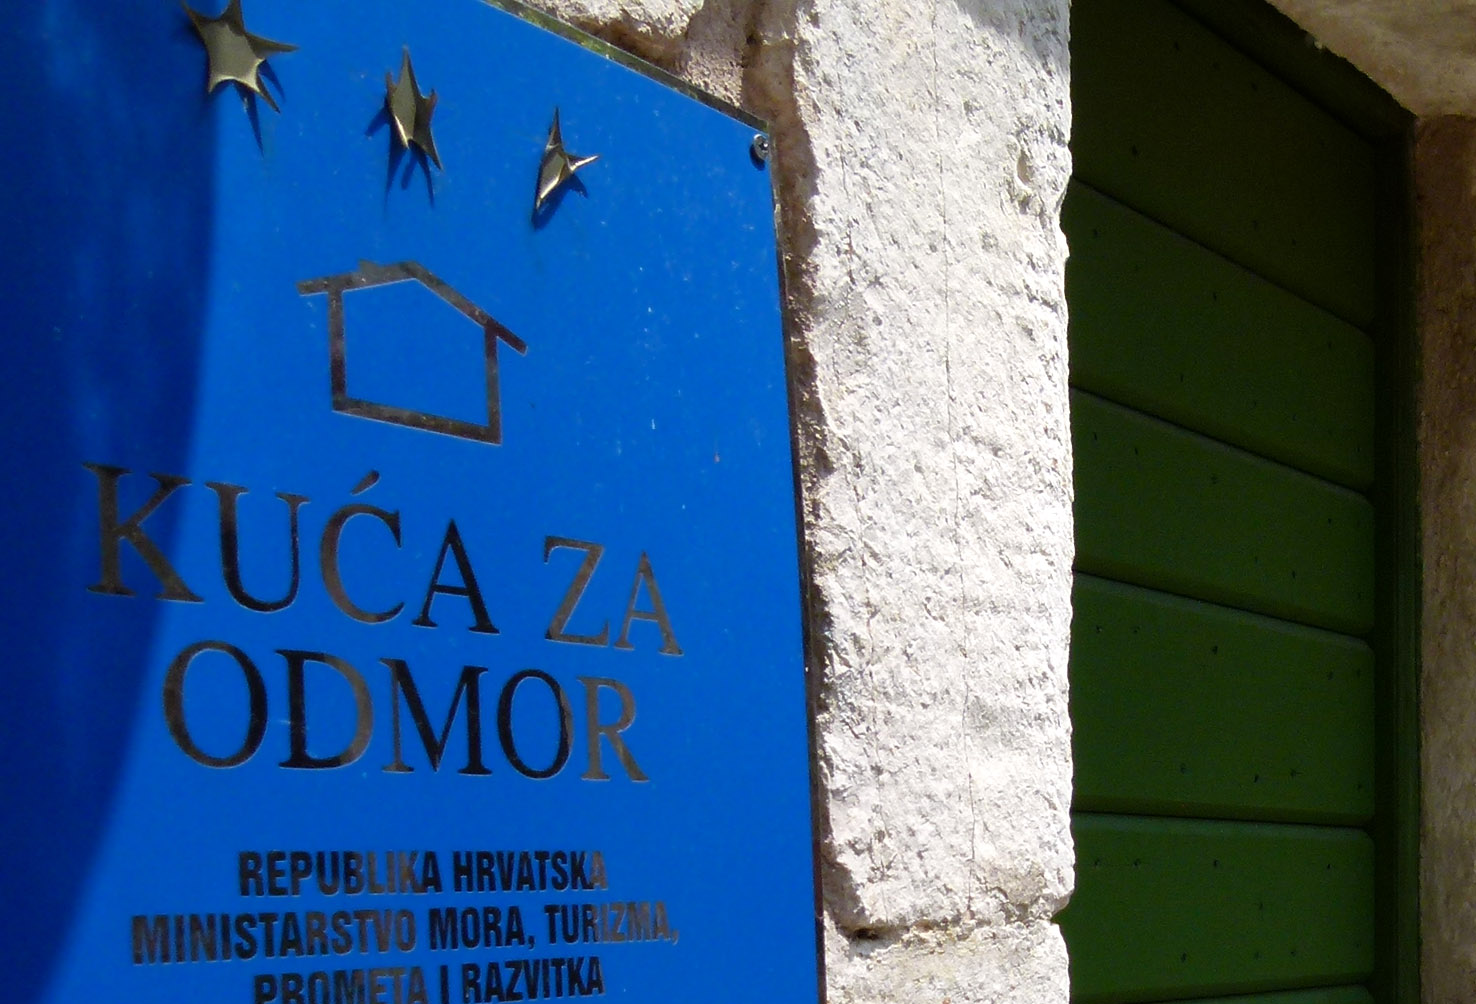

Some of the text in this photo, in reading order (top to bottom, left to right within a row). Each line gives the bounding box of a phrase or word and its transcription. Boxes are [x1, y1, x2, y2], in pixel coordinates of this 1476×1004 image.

[83, 461, 684, 657] KUĆA ZA
[162, 639, 650, 784] ODMOR
[238, 850, 609, 897] REPUBLIKA HRVATSKA
[131, 900, 680, 965] MINISTARSTVO MORA, TURIZMA,
[462, 956, 605, 1003] RAZVITKA
